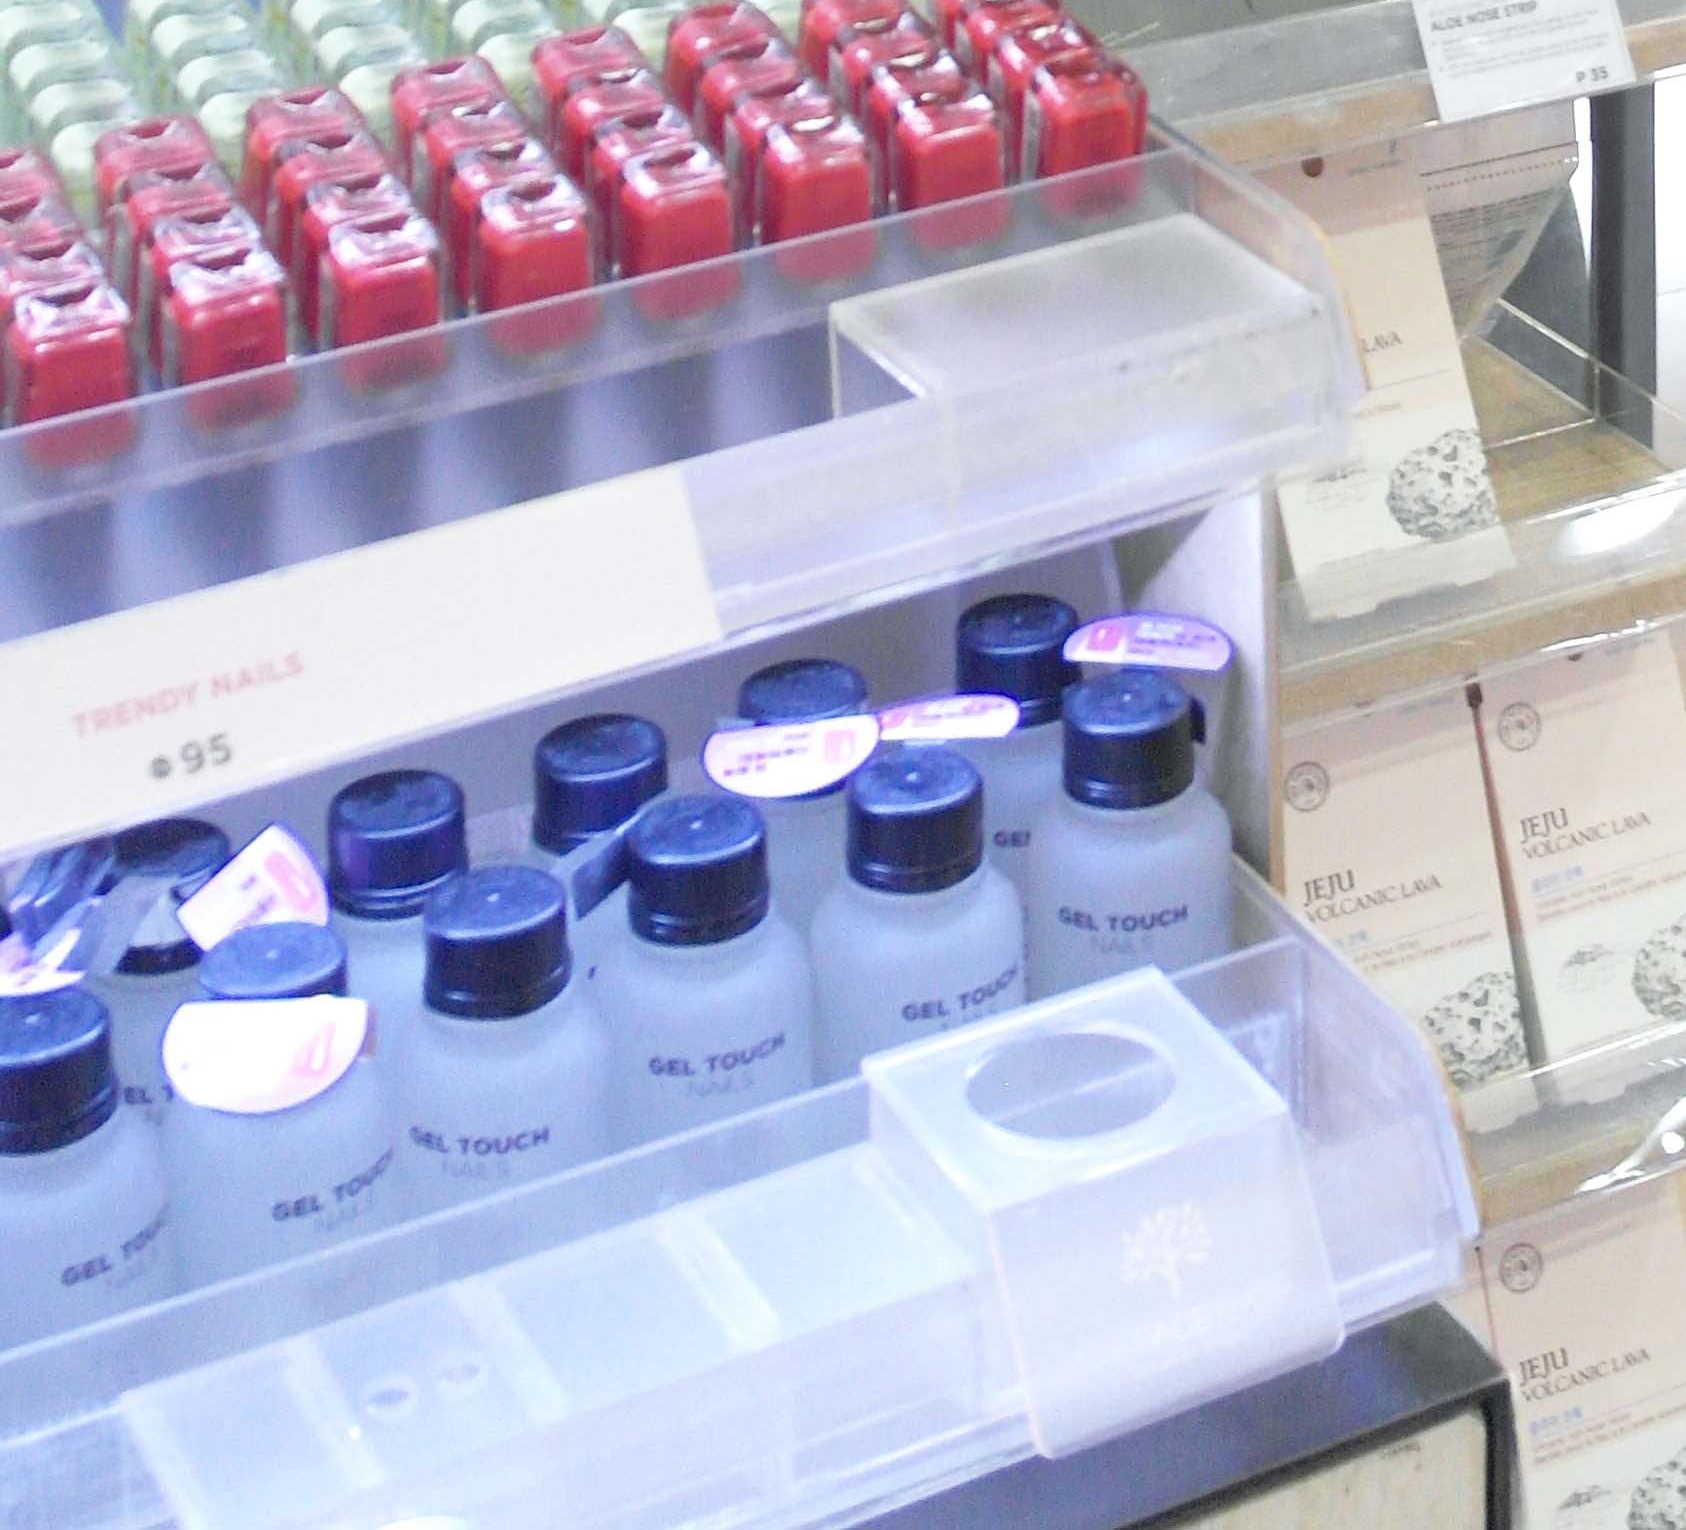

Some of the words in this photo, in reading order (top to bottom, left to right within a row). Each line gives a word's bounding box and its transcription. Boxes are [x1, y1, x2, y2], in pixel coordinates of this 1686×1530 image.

[72, 682, 199, 738] TRENDY
[210, 650, 304, 699] NAILS
[1519, 807, 1569, 844] JEJU
[1522, 822, 1608, 860] VOLCANIC
[1303, 869, 1355, 907] JEJU
[1305, 885, 1396, 923] VOLCANIC
[1058, 905, 1099, 931] GEL
[1106, 904, 1190, 932] TOUCH
[901, 999, 950, 1022] GEL
[648, 1055, 697, 1077] GEL
[703, 1031, 786, 1074] TOUCH
[123, 1085, 153, 1106] EL
[458, 1125, 551, 1156] TOUCH
[271, 1194, 323, 1223] GEL
[60, 1254, 112, 1287] GEL
[1518, 1346, 1569, 1388] JEJU
